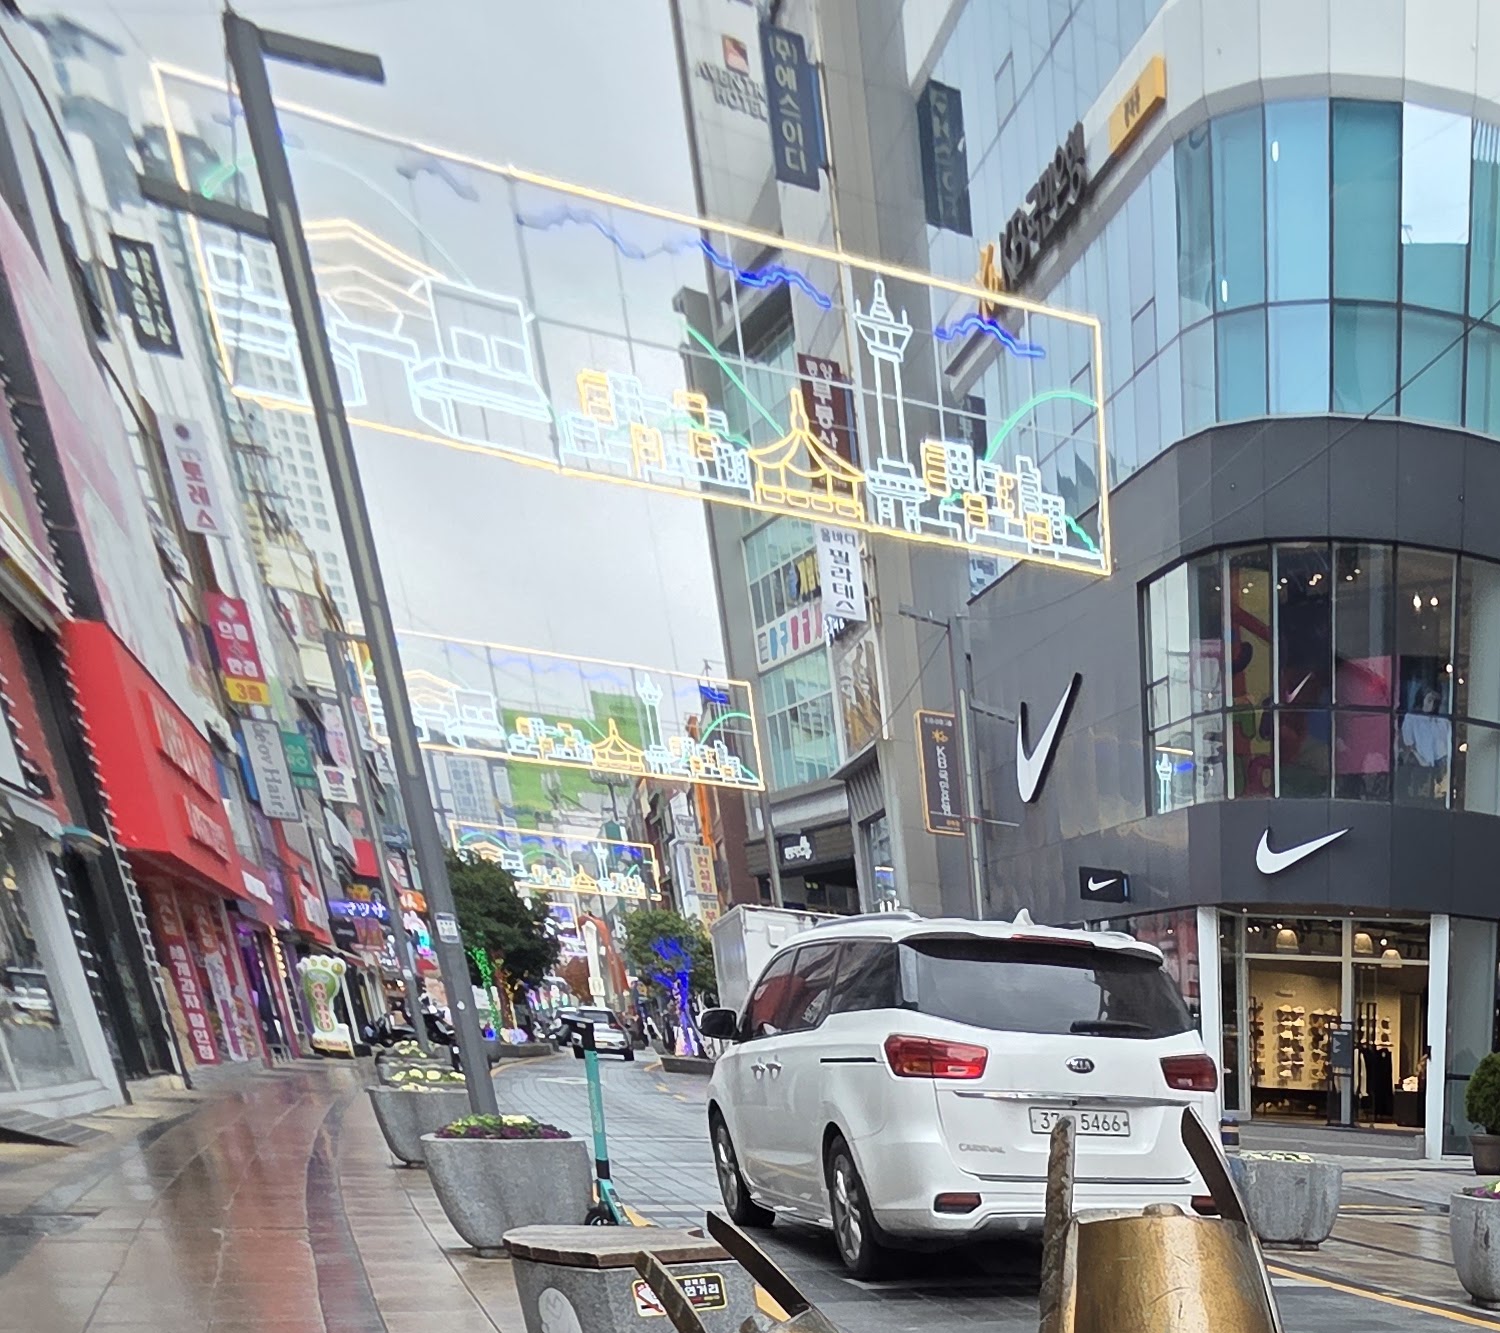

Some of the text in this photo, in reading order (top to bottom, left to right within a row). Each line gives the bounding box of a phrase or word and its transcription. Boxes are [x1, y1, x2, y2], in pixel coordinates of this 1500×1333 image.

[768, 35, 807, 175] (주)에스이디
[829, 549, 857, 615] 필라테스
[1080, 1113, 1122, 1133] 5466
